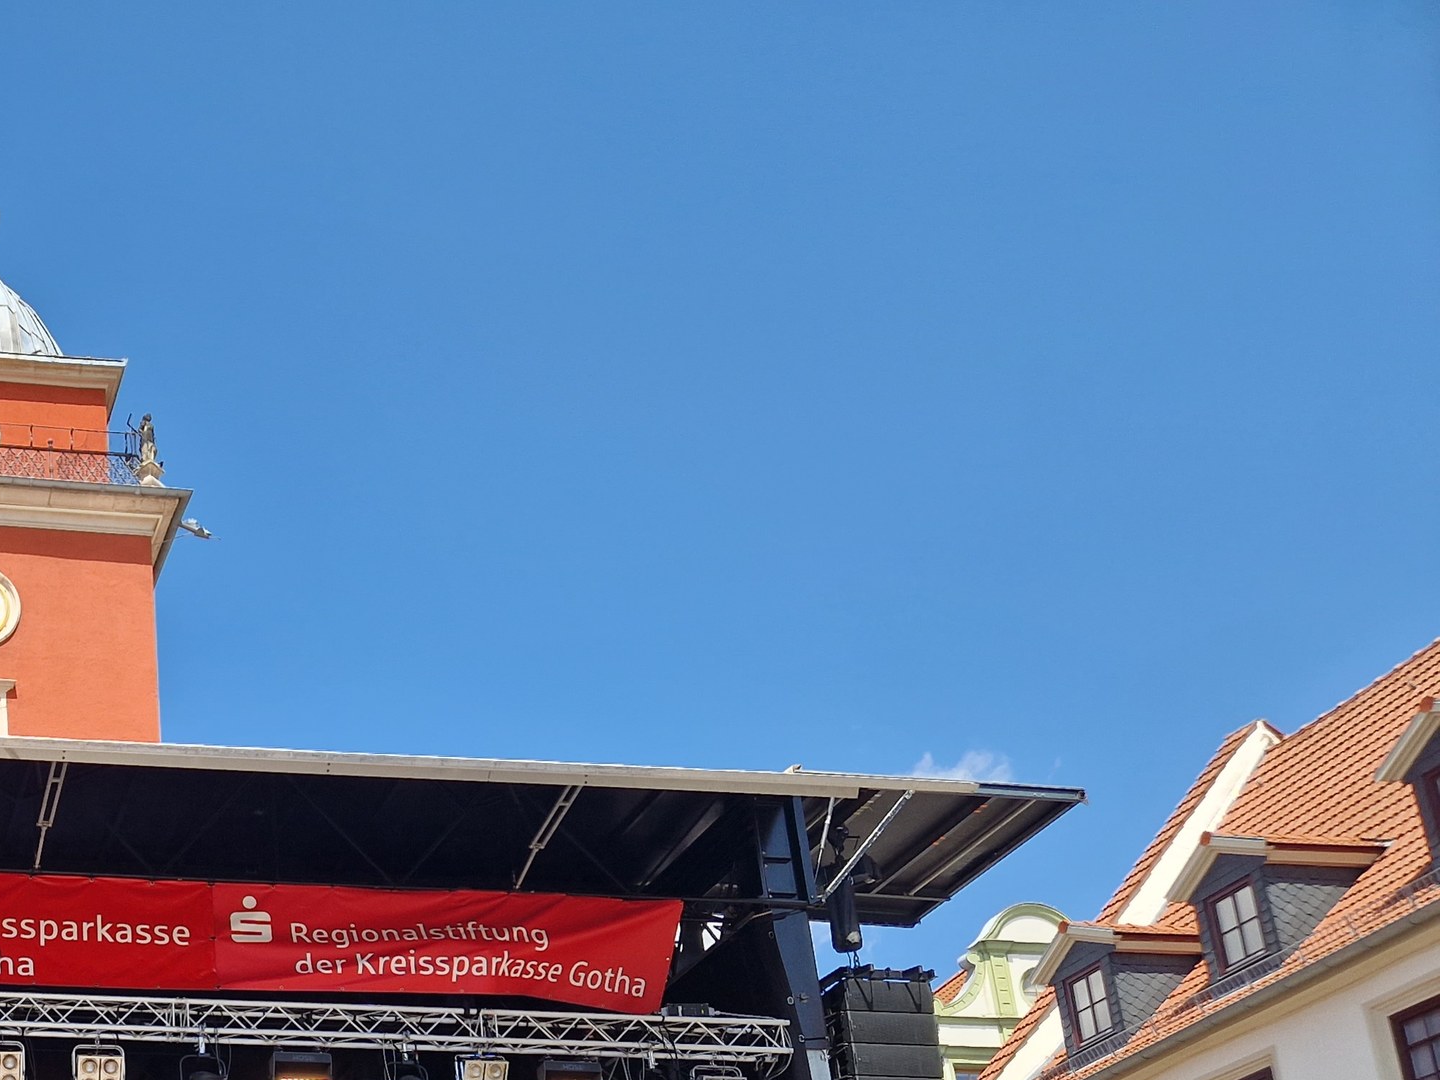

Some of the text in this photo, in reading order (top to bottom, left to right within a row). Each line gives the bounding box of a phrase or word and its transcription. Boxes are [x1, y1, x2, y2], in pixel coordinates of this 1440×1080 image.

[289, 921, 550, 952] Regionalstiftung
[295, 949, 647, 998] der Kreissparkasse Gotha
